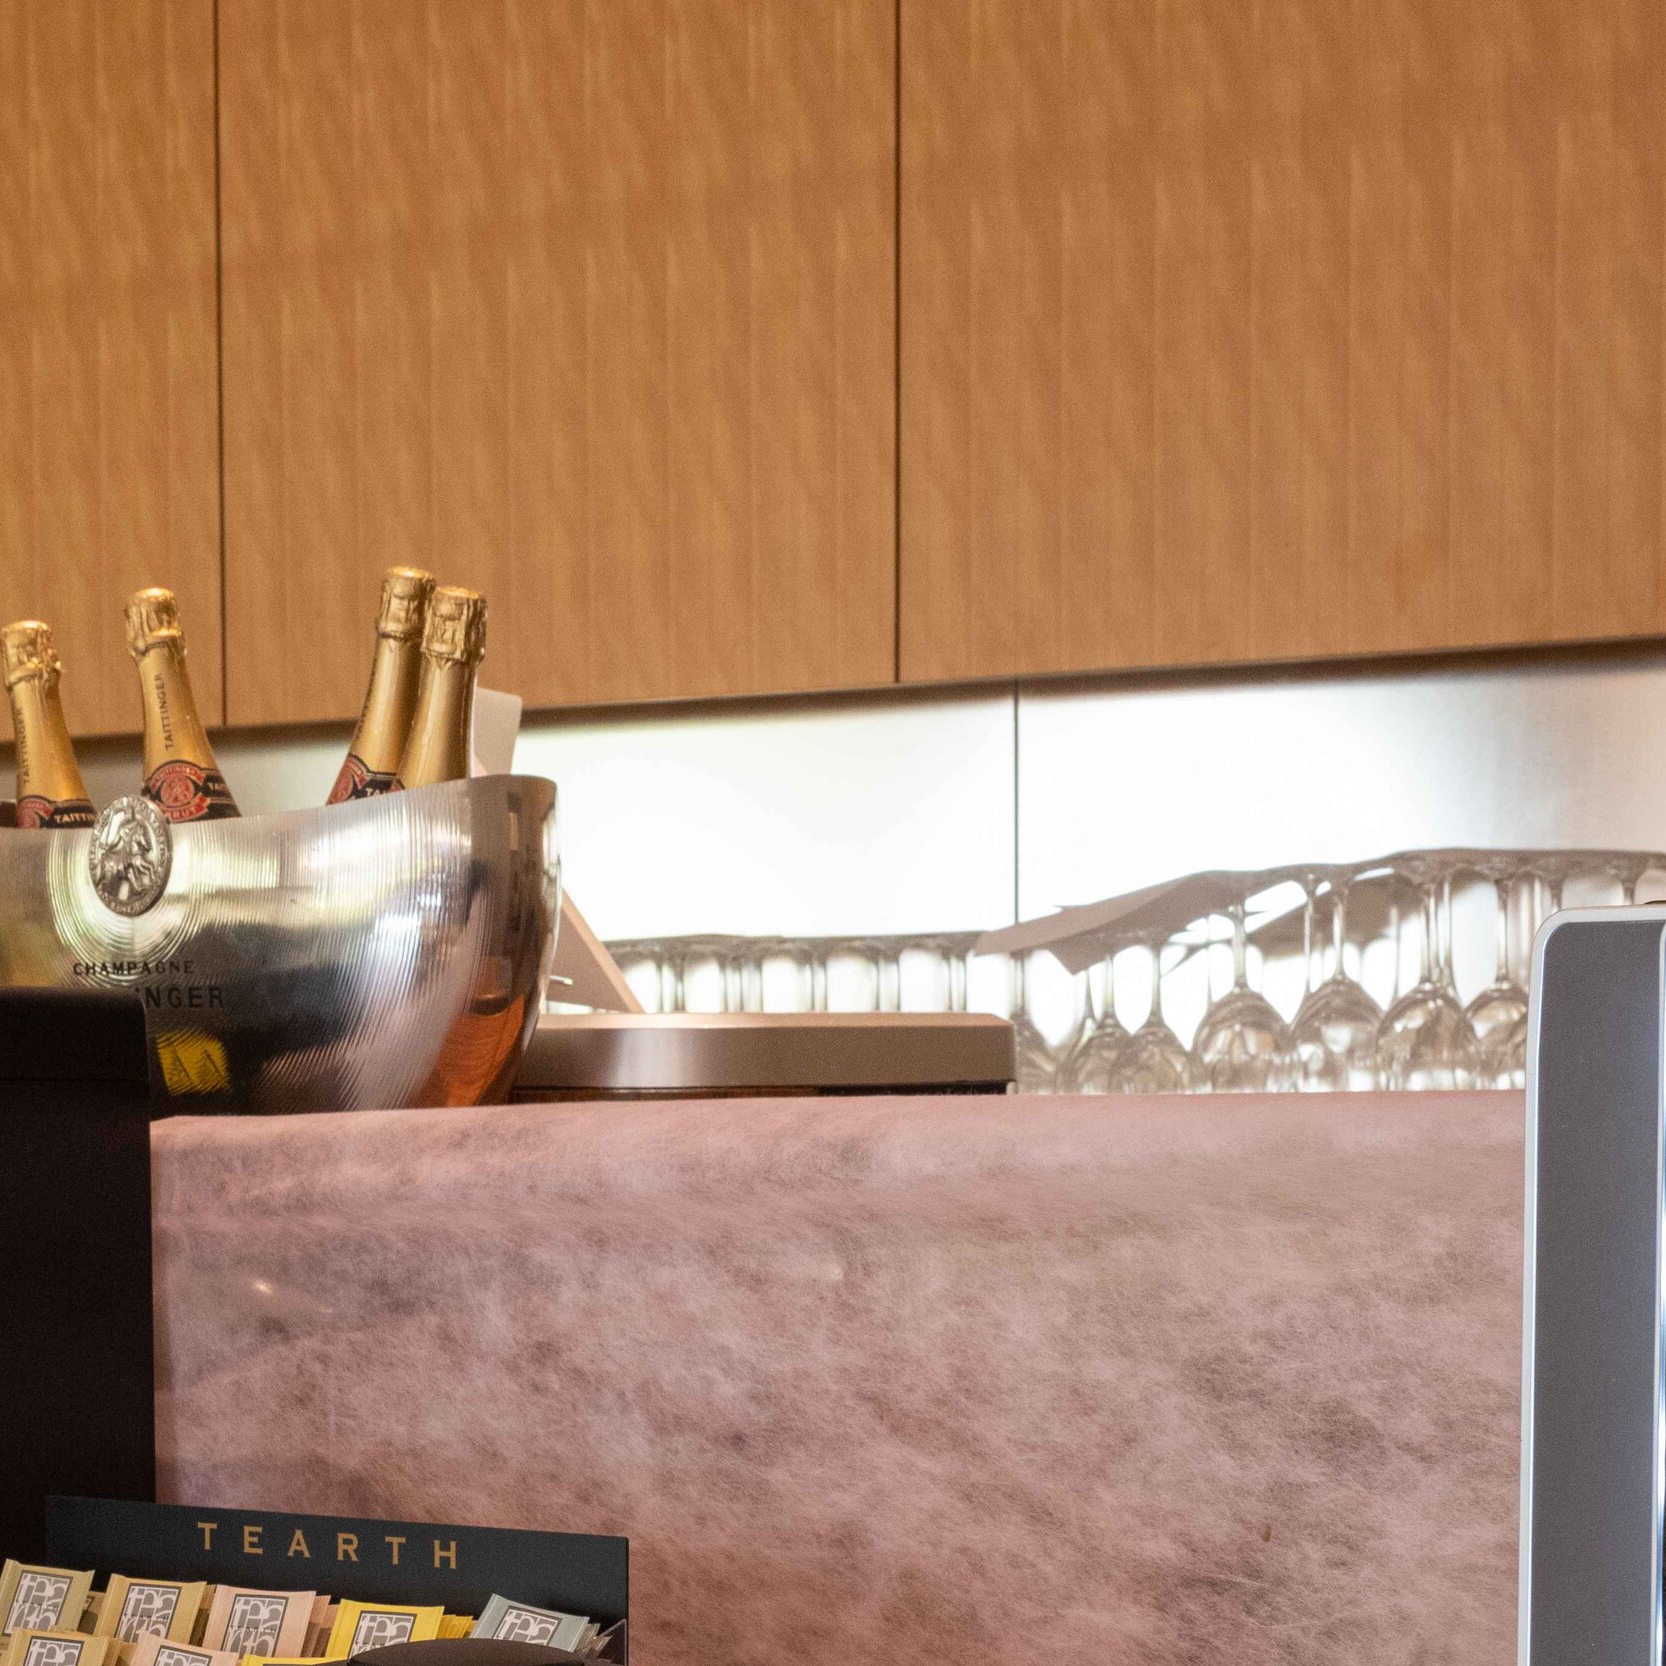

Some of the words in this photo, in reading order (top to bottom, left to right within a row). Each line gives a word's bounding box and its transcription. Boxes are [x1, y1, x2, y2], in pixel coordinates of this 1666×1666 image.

[153, 673, 176, 750] TAITTINGER
[73, 960, 195, 976] CHAMPAGNE
[197, 1521, 459, 1570] TEARTH
